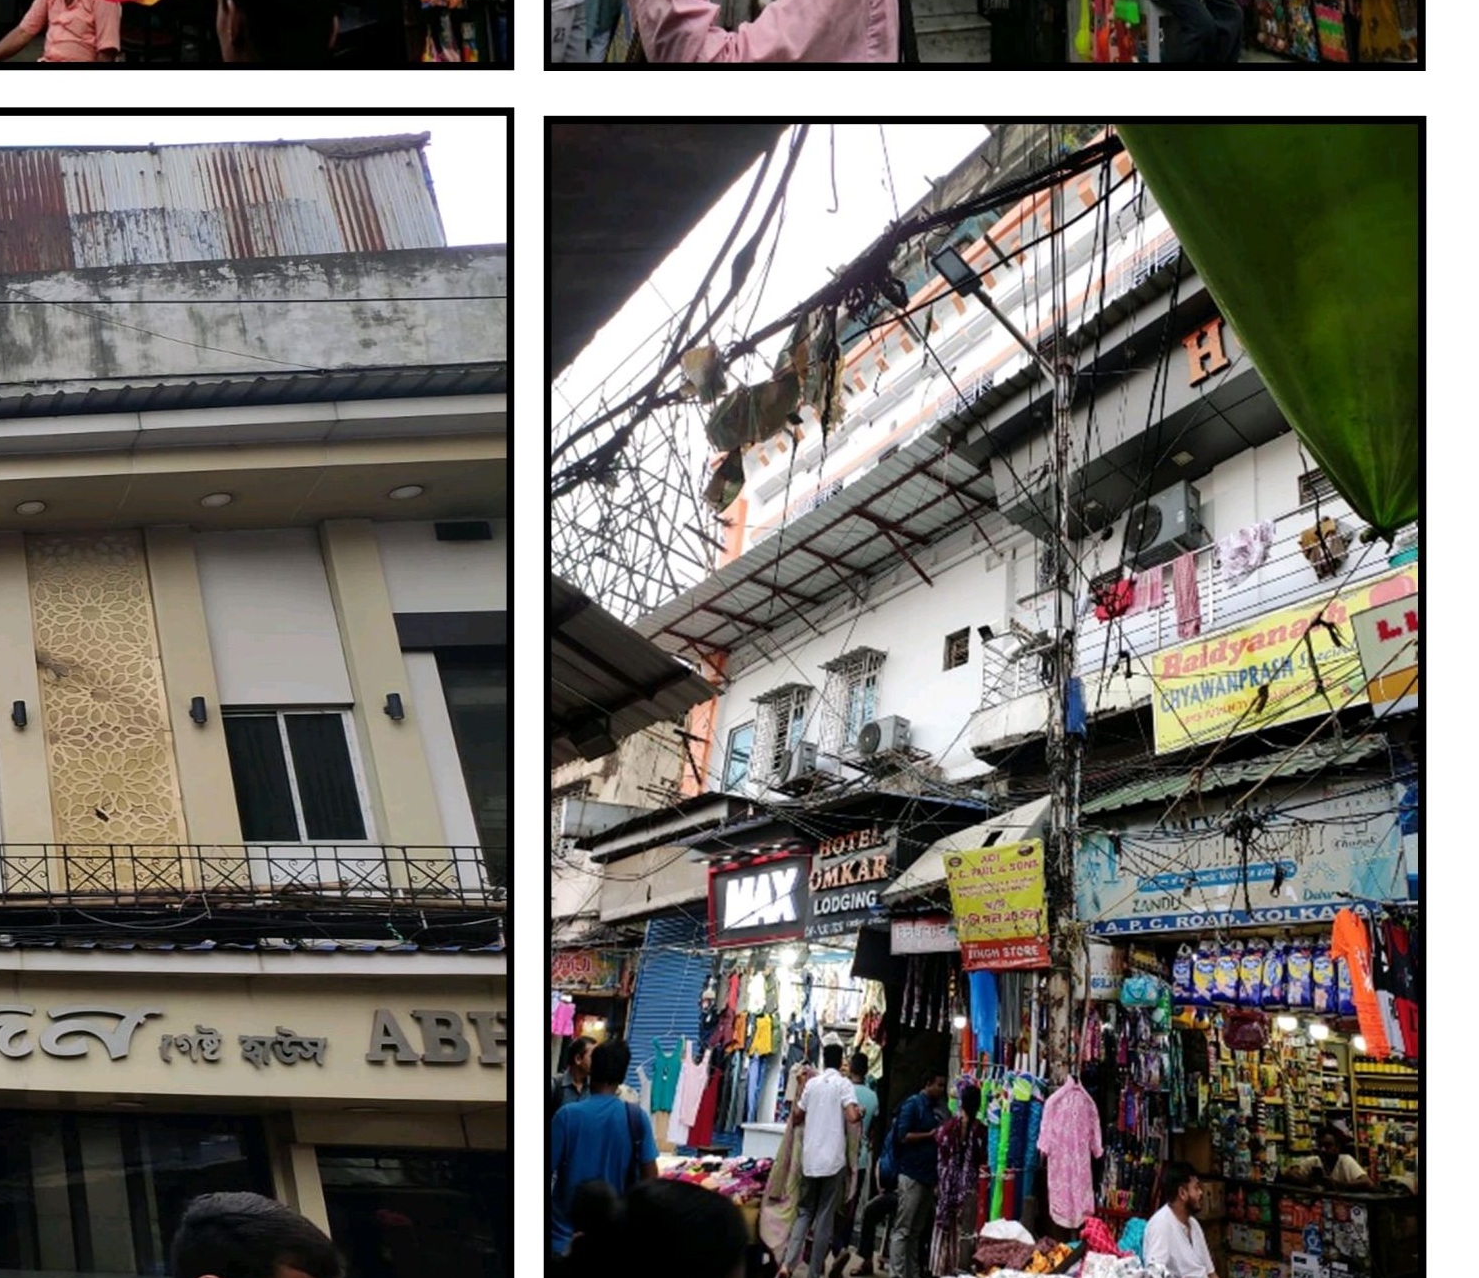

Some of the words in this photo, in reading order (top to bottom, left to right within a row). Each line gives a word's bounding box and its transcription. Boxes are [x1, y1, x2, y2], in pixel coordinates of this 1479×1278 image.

[1160, 656, 1296, 713] CHYAWANPRASH
[819, 827, 883, 857] HOTEL
[809, 854, 889, 891] OMKAR
[1009, 859, 1039, 870] SONS
[723, 867, 800, 930] MAX
[813, 890, 877, 915] LODGING
[1131, 896, 1181, 913] ZANDU
[1002, 945, 1039, 957] STORE
[242, 1026, 327, 1069] হাউস
